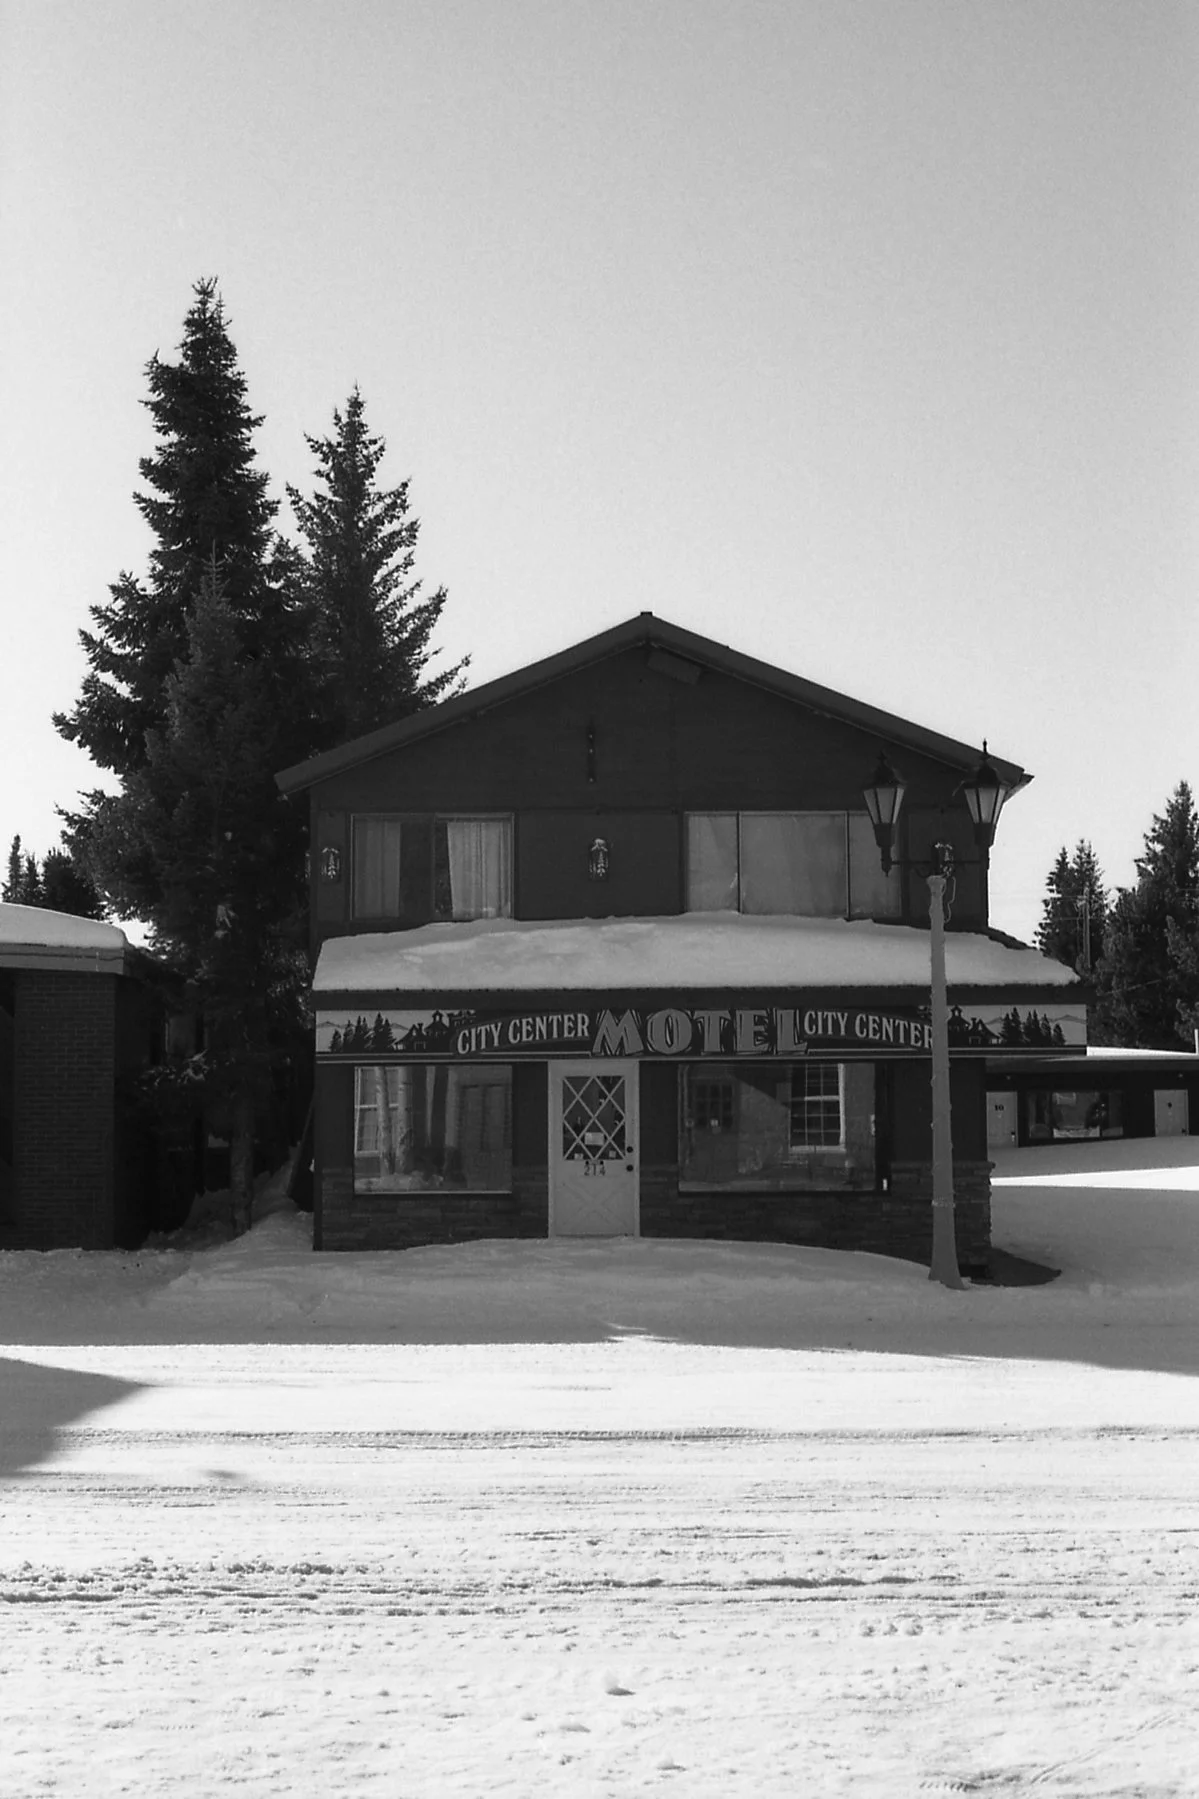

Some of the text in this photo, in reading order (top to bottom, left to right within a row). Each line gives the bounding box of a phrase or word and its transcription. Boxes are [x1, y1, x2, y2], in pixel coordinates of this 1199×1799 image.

[457, 1013, 589, 1054] CITY CENTER
[592, 1008, 808, 1055] MOTEL
[804, 1010, 932, 1048] CITY CENTER
[584, 1164, 606, 1176] 214
